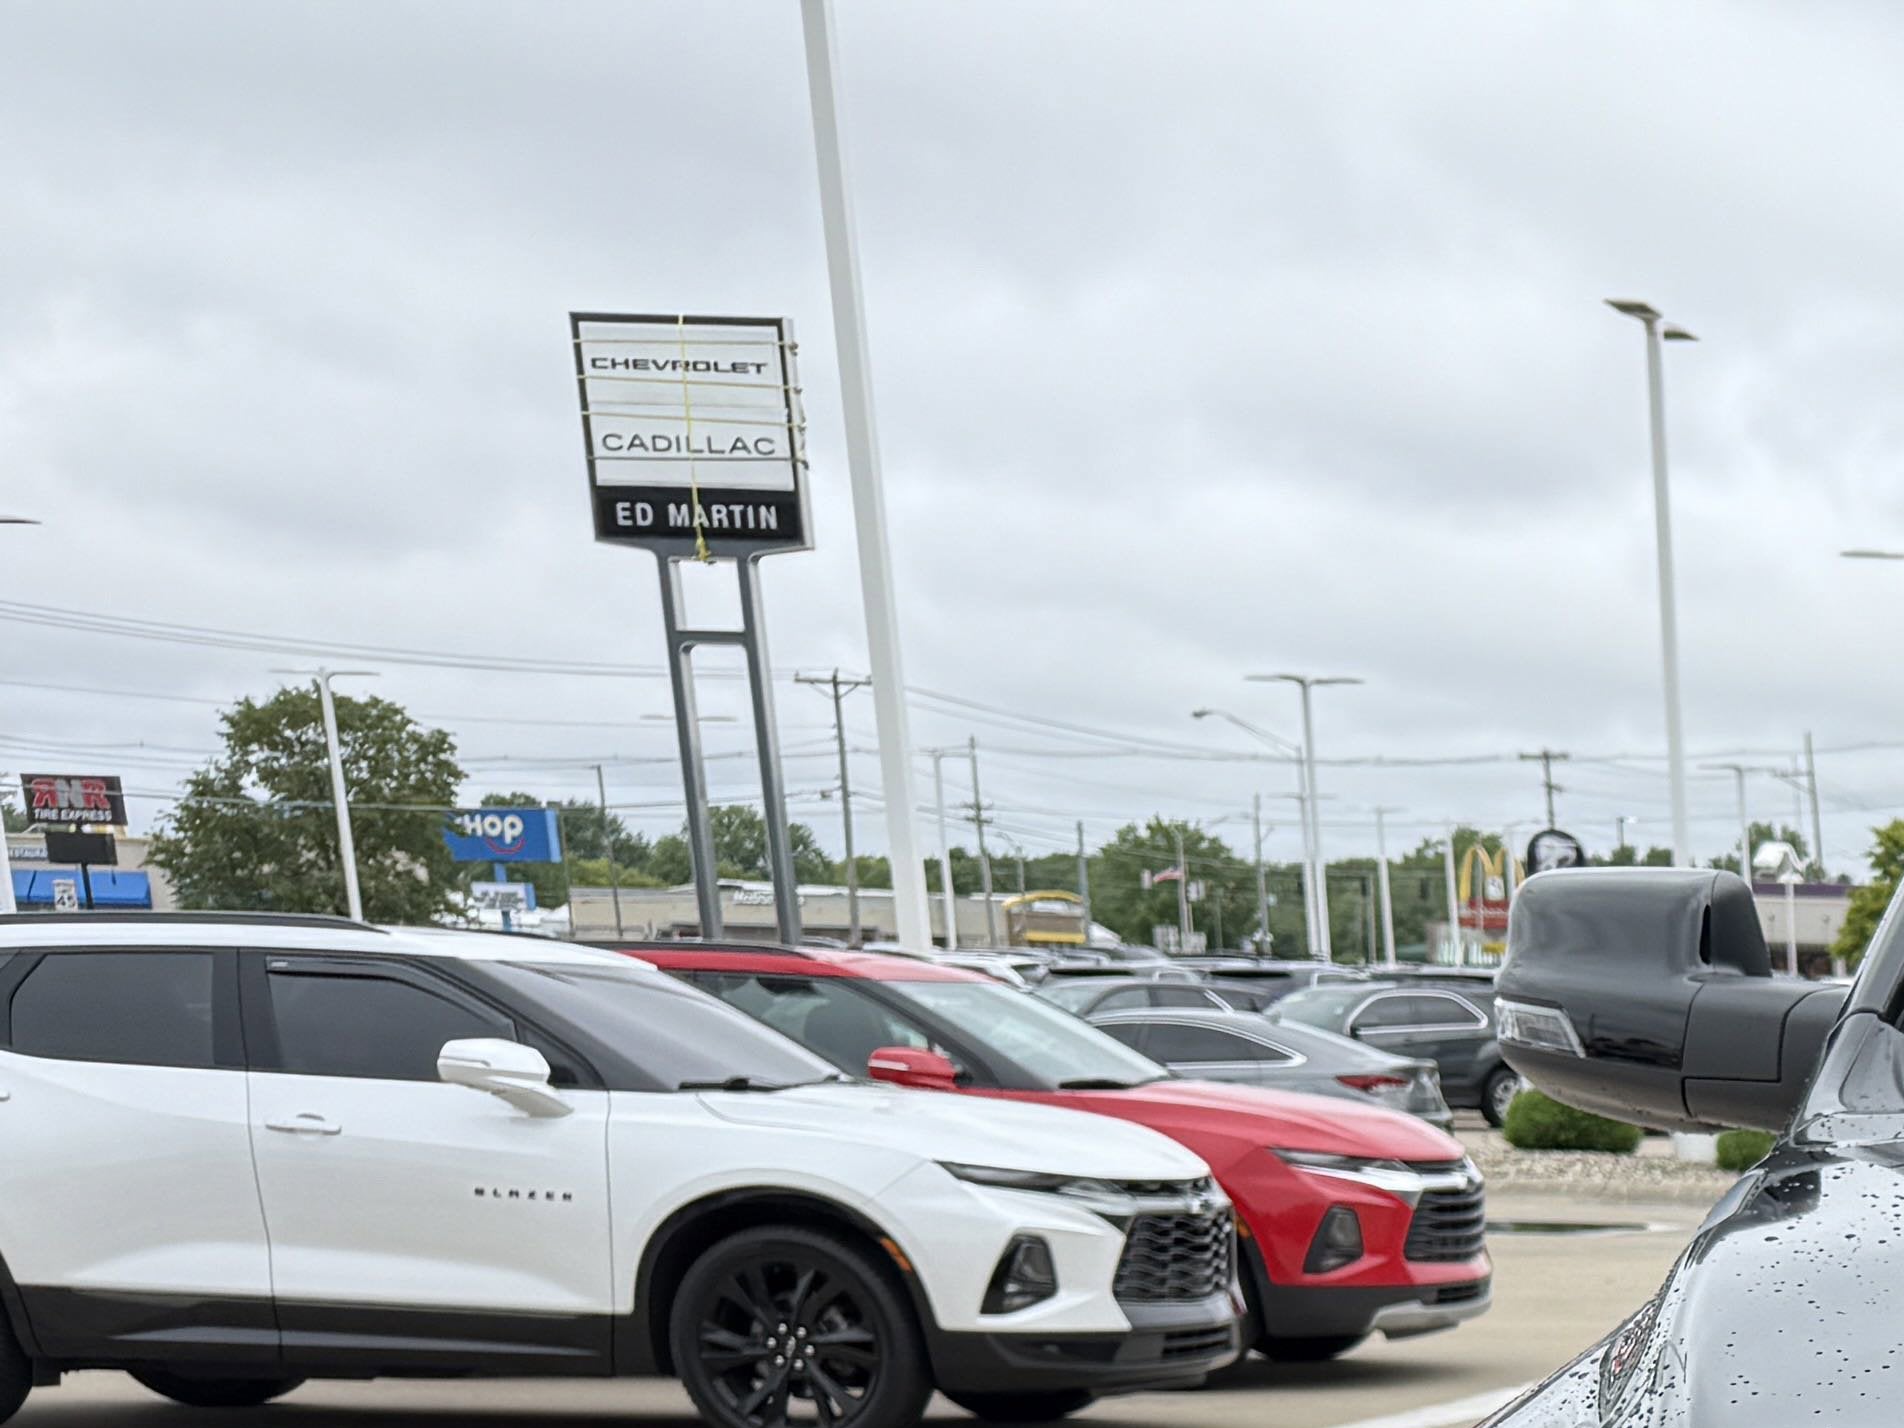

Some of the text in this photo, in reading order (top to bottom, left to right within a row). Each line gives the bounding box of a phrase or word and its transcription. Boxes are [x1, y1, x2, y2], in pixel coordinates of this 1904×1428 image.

[590, 357, 768, 374] CHEVROLET
[601, 433, 776, 456] CADILLAC
[615, 502, 778, 530] ED MARTIN
[35, 808, 112, 822] TIRE EXPRESS
